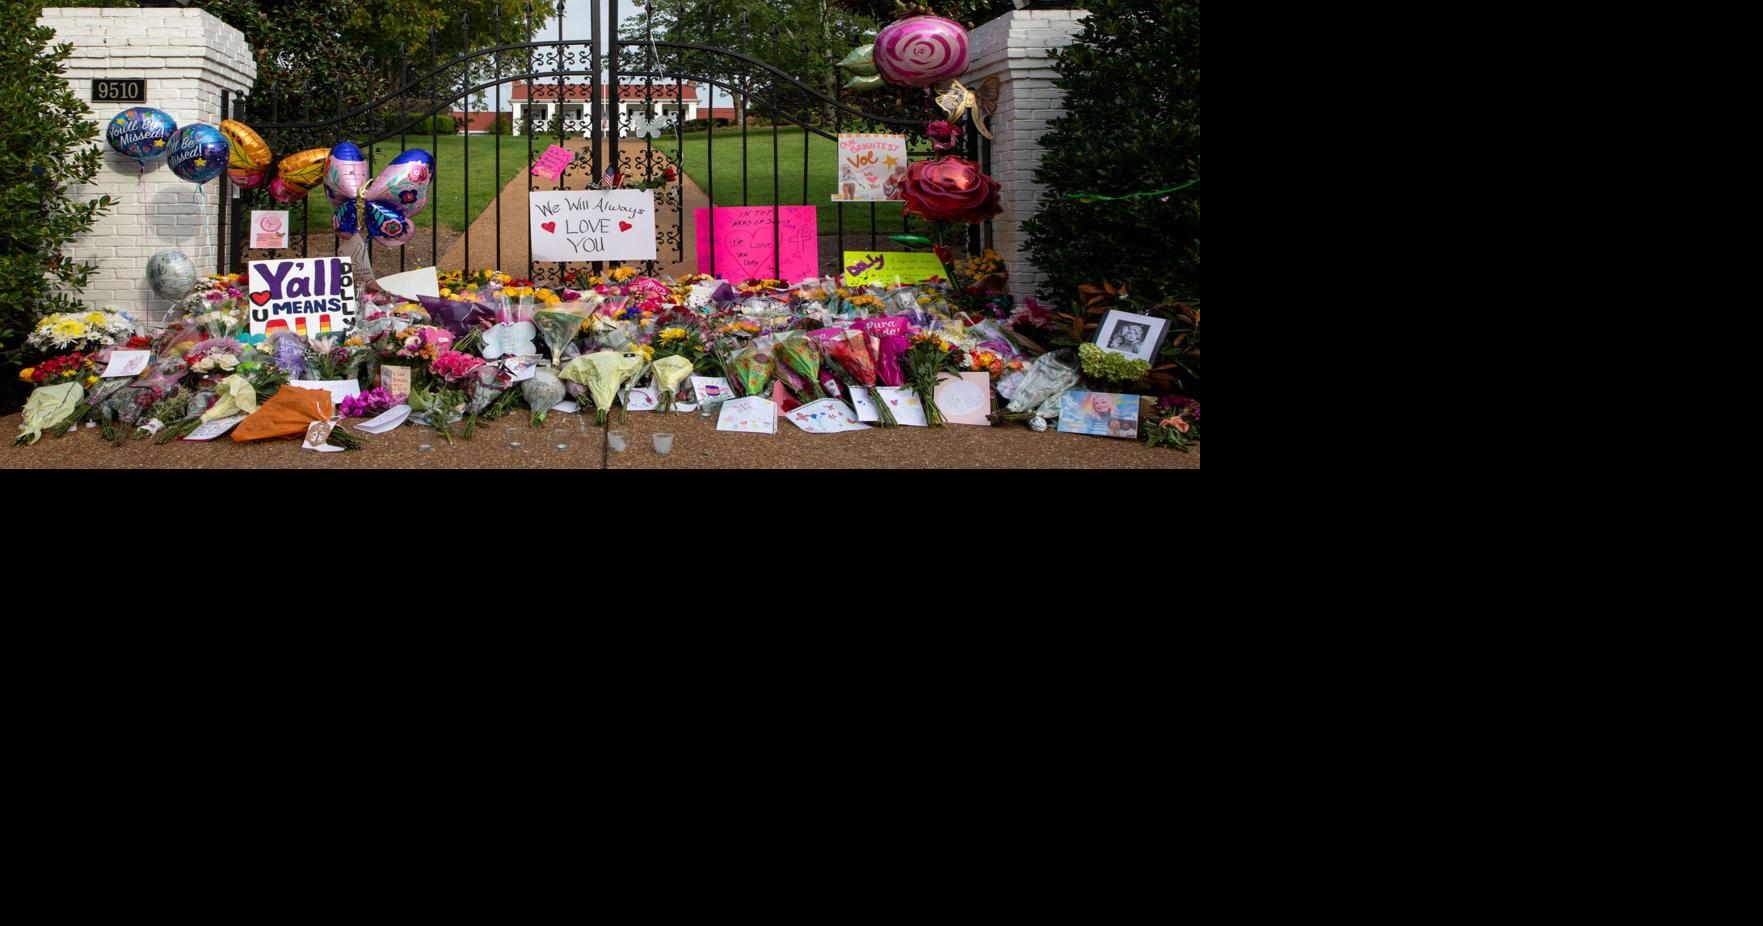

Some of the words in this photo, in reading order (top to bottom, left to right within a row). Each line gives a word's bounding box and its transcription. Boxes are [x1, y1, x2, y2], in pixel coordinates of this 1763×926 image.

[98, 82, 138, 98] 9510
[120, 127, 164, 146] Missed!
[181, 137, 195, 149] Be
[536, 200, 560, 217] We
[565, 197, 589, 211] Will
[594, 197, 645, 219] Always
[565, 218, 611, 235] LOVE
[566, 237, 605, 253] YOU
[253, 258, 341, 300] Y'all
[340, 262, 357, 332] DOLLY
[252, 308, 269, 322] U
[272, 298, 342, 315] MEANS
